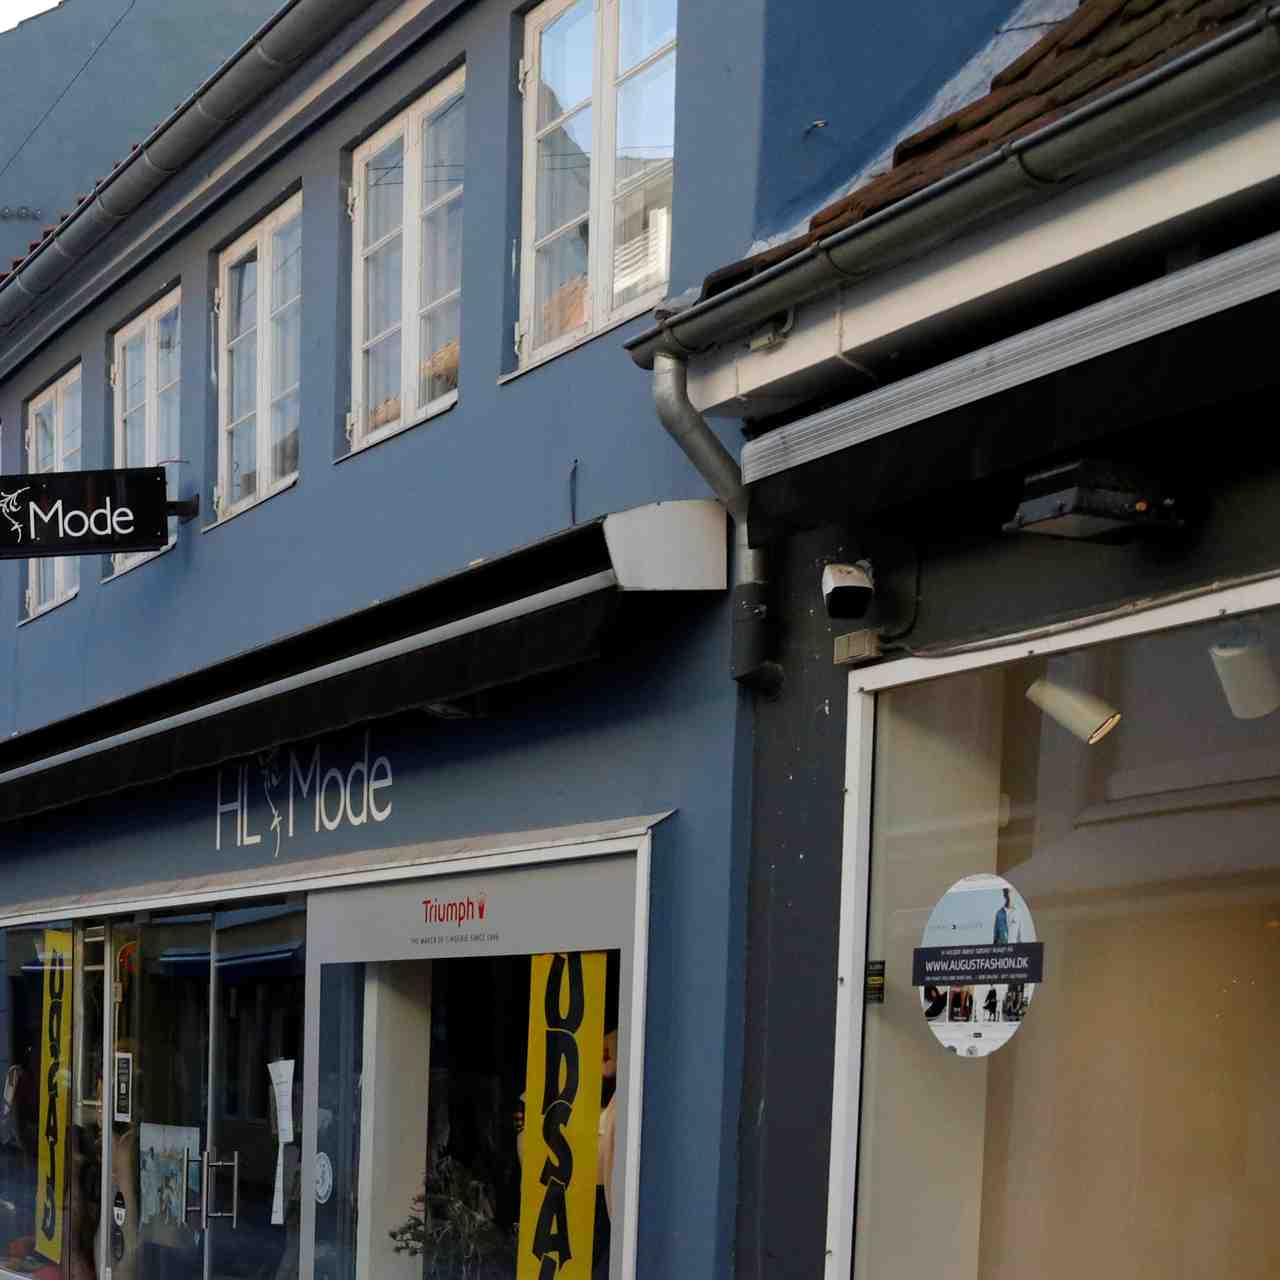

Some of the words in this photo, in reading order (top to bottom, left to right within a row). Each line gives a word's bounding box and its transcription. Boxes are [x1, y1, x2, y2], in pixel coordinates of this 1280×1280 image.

[29, 496, 134, 539] Mode
[215, 762, 261, 850] HL
[288, 728, 392, 838] Mode
[422, 896, 474, 928] Triumph
[925, 957, 1029, 972] WWW.AUGUSTFASHION.DK
